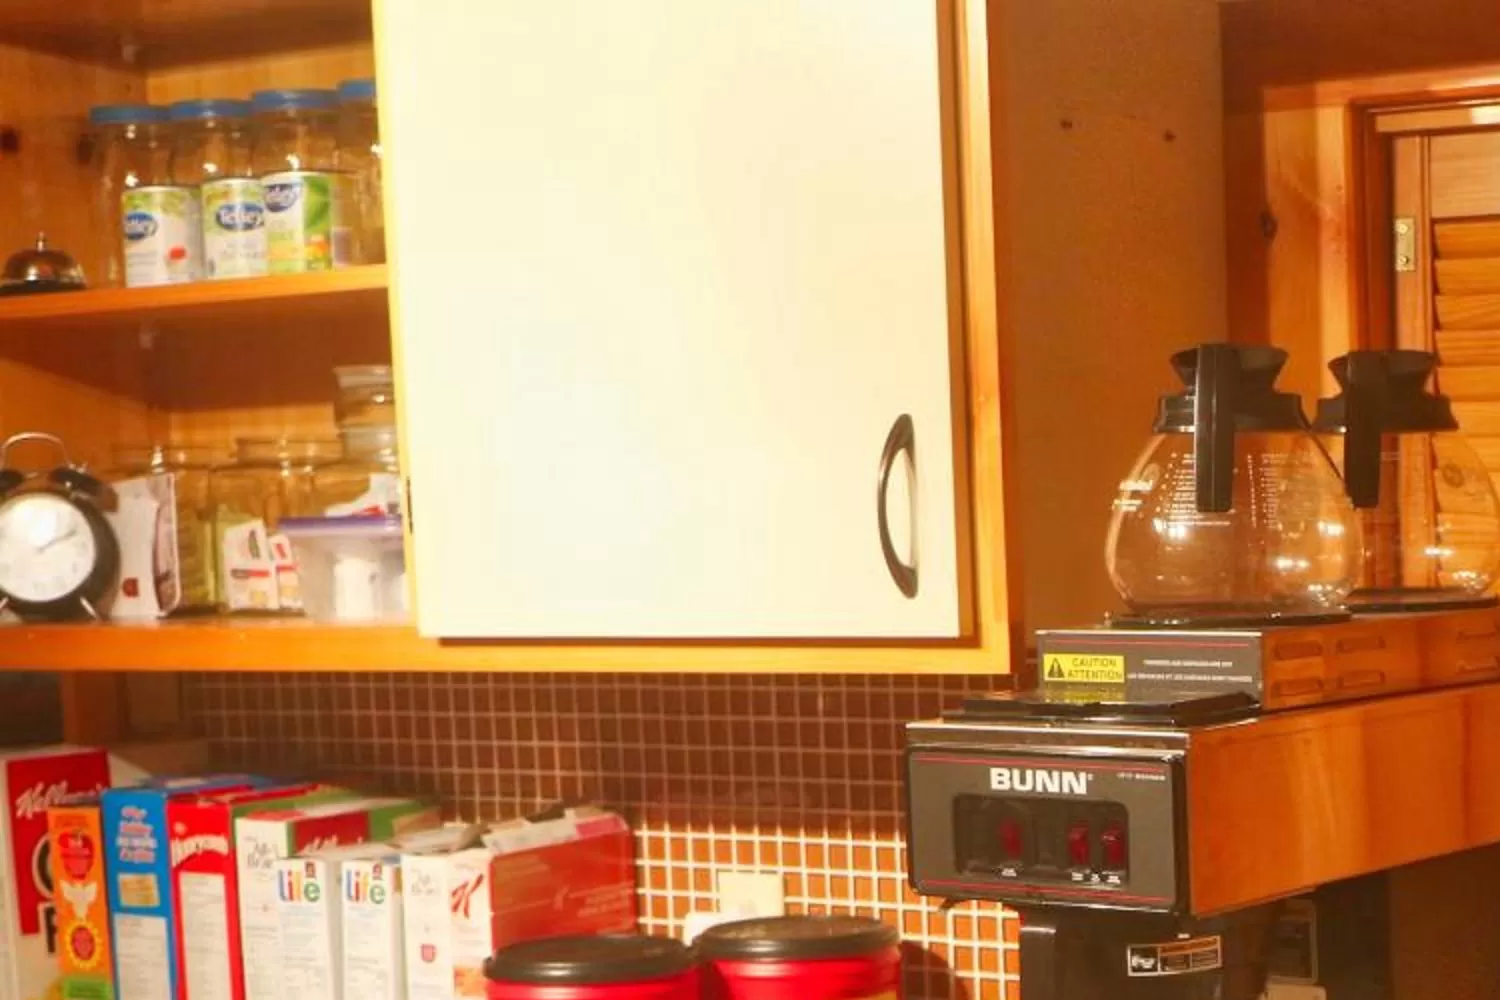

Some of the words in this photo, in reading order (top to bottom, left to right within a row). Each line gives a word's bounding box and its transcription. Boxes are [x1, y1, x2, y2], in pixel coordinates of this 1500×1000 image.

[1071, 656, 1117, 667] CAUTION
[1067, 669, 1123, 680] ATTENTION
[989, 767, 1088, 795] BUNN
